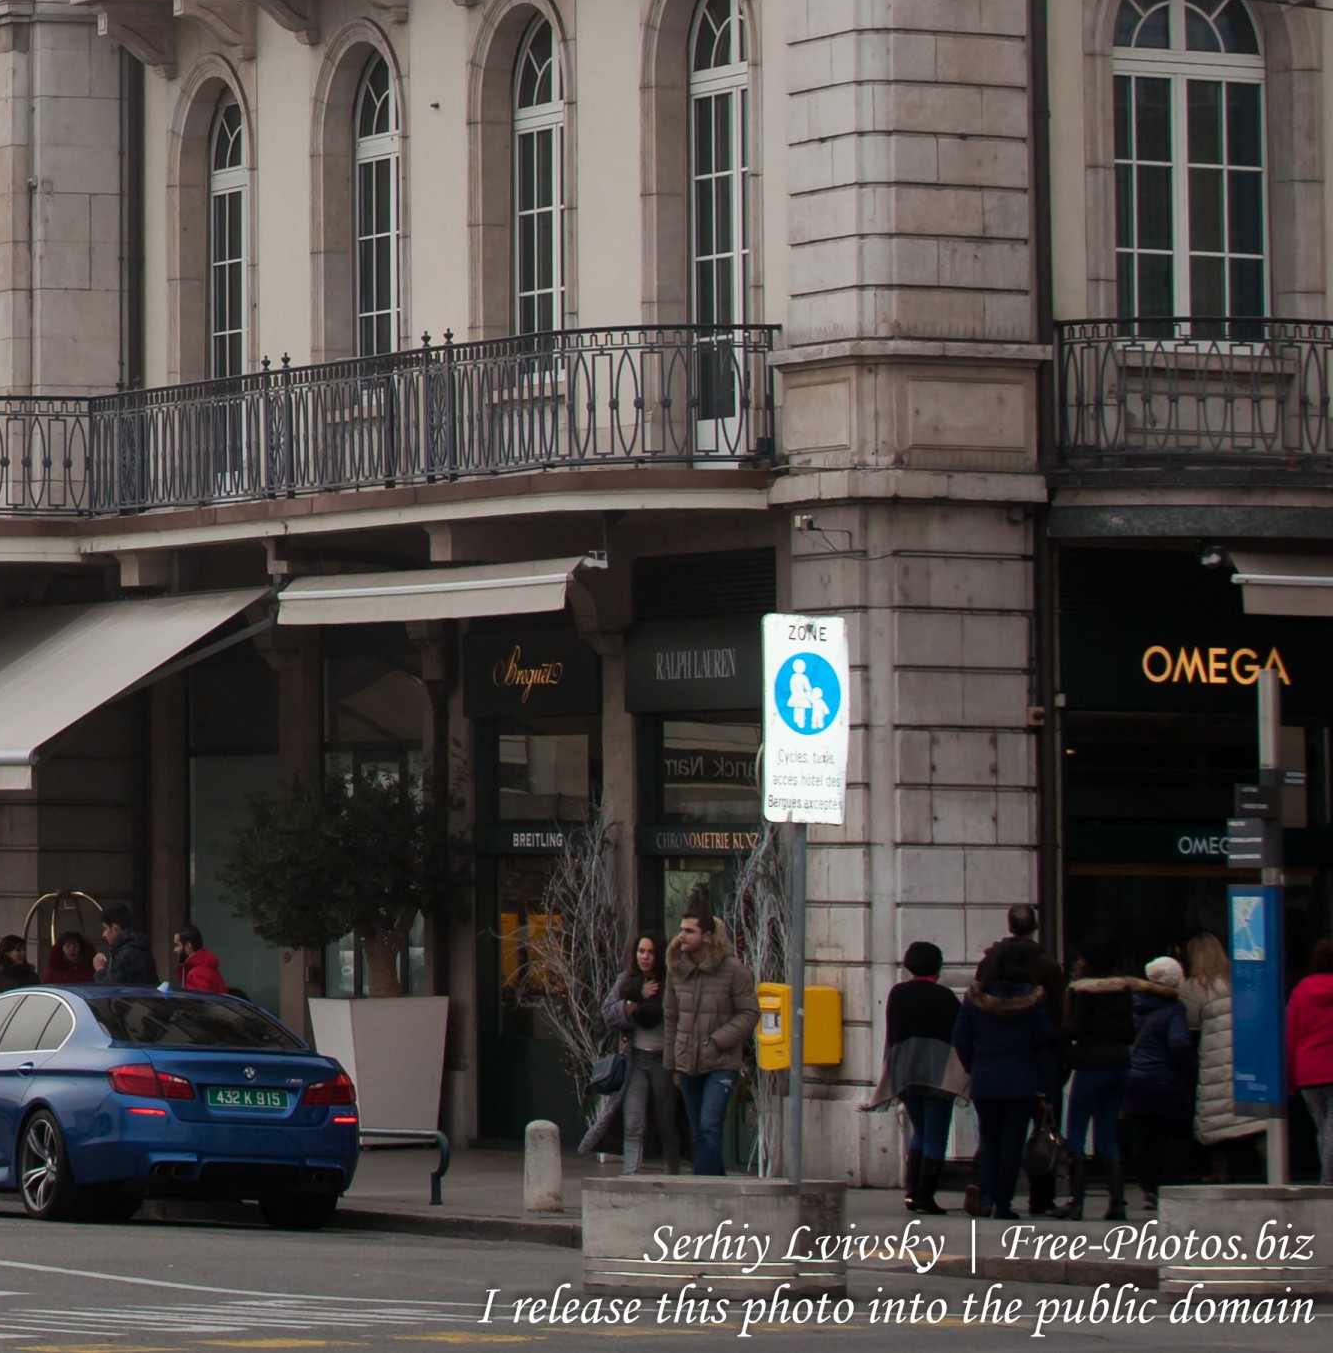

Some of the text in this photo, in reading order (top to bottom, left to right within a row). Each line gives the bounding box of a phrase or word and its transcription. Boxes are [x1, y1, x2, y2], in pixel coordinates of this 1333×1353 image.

[787, 624, 828, 642] ZONE
[656, 648, 736, 680] RALPH LAUREN
[1141, 645, 1292, 686] OMEGA
[492, 644, 564, 704] Breguet
[826, 774, 842, 788] des
[512, 832, 564, 848] BREITLING
[656, 832, 759, 850] CHRONOMETRIE KUNZ
[1177, 836, 1230, 855] OMEG
[216, 1090, 281, 1106] 432 K 915
